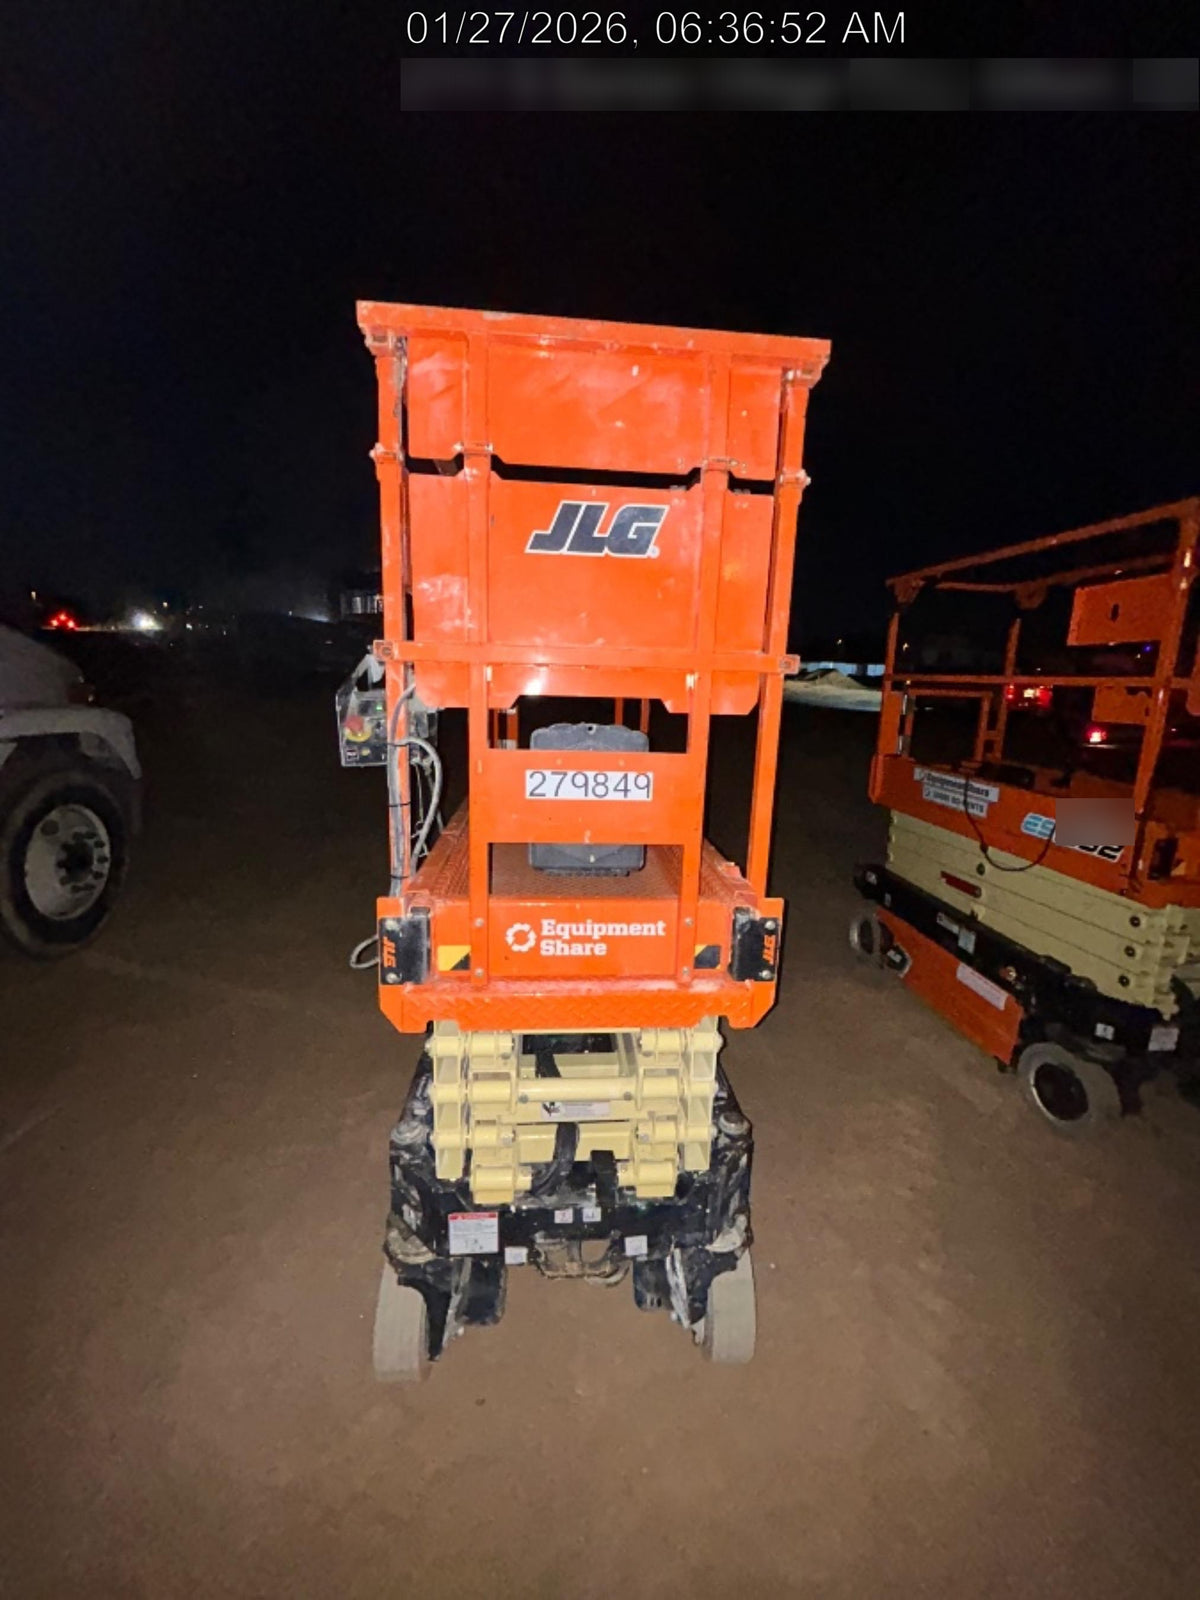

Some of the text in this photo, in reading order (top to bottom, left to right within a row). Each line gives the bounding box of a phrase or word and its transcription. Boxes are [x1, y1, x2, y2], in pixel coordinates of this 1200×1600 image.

[525, 501, 669, 558] JLG
[528, 771, 652, 799] 279849
[540, 918, 666, 940] Equipment
[540, 939, 608, 956] Share
